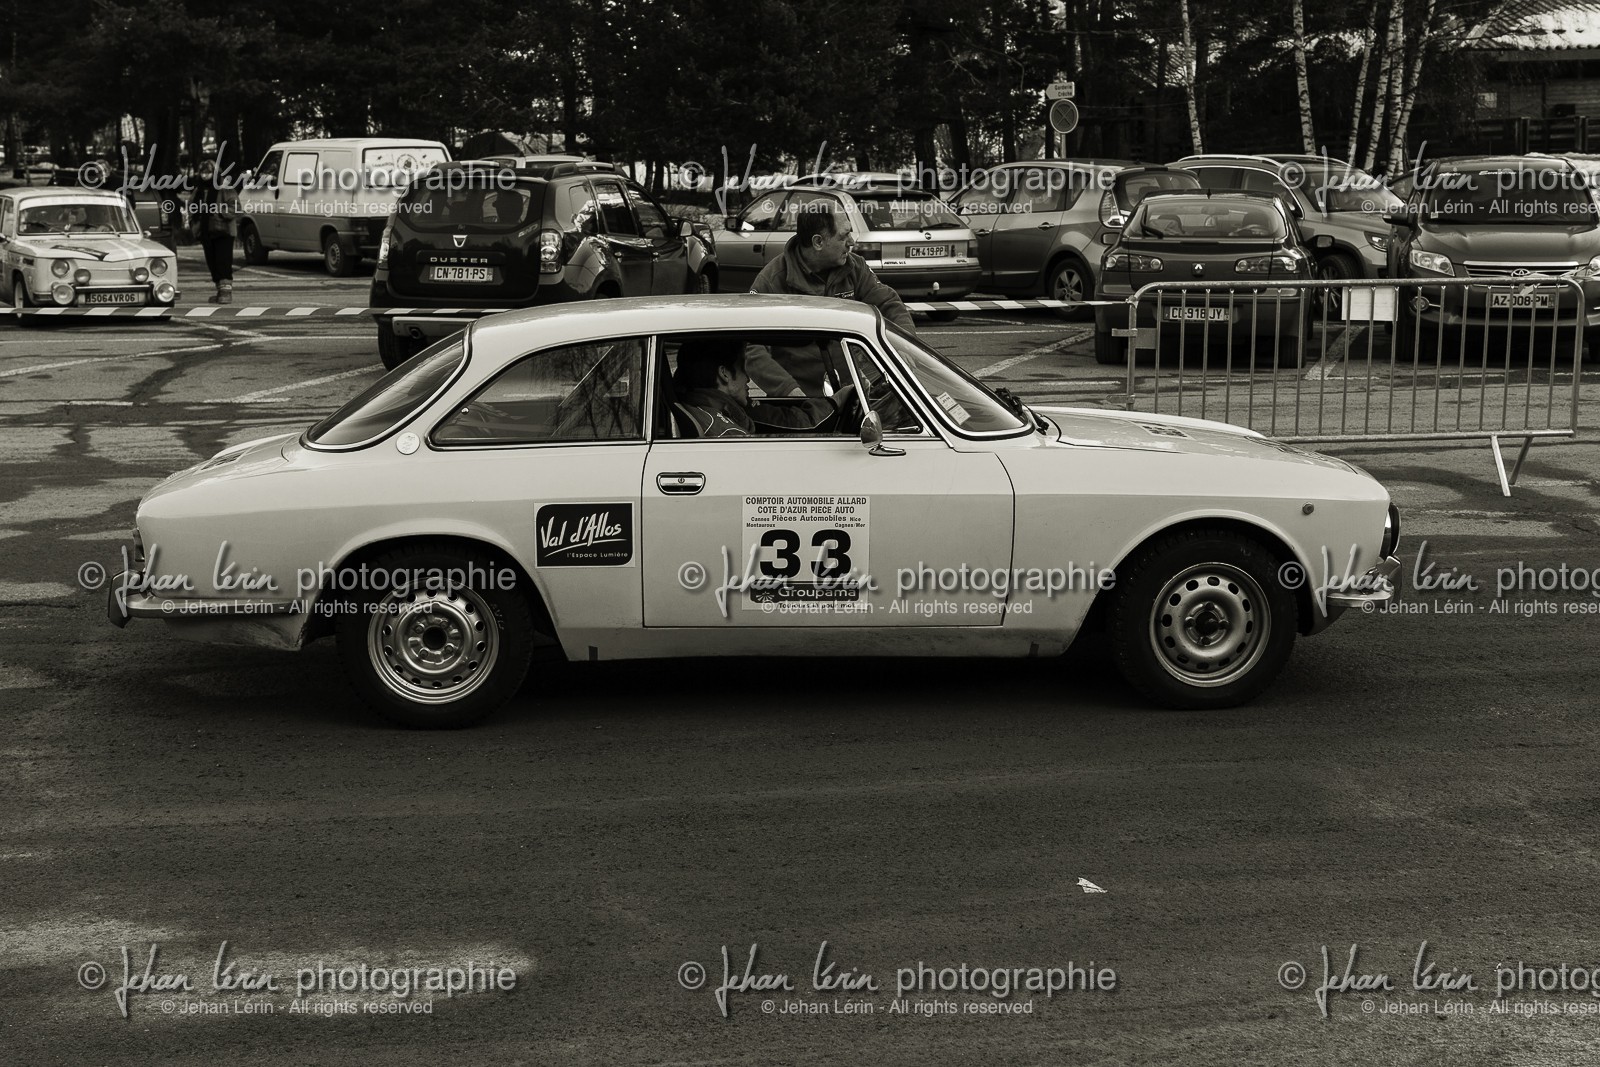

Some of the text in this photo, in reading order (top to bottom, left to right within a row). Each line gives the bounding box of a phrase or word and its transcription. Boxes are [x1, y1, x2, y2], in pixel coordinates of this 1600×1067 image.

[436, 268, 486, 279] CN-781-PS
[745, 497, 867, 505] COMPTOIR AUTOMOBILE ALLARD
[757, 506, 855, 514] COTE D'AZUR PIECE AUTO
[541, 511, 622, 549] Val d'Allos
[760, 529, 851, 578] 33
[778, 588, 856, 599] Groupama
